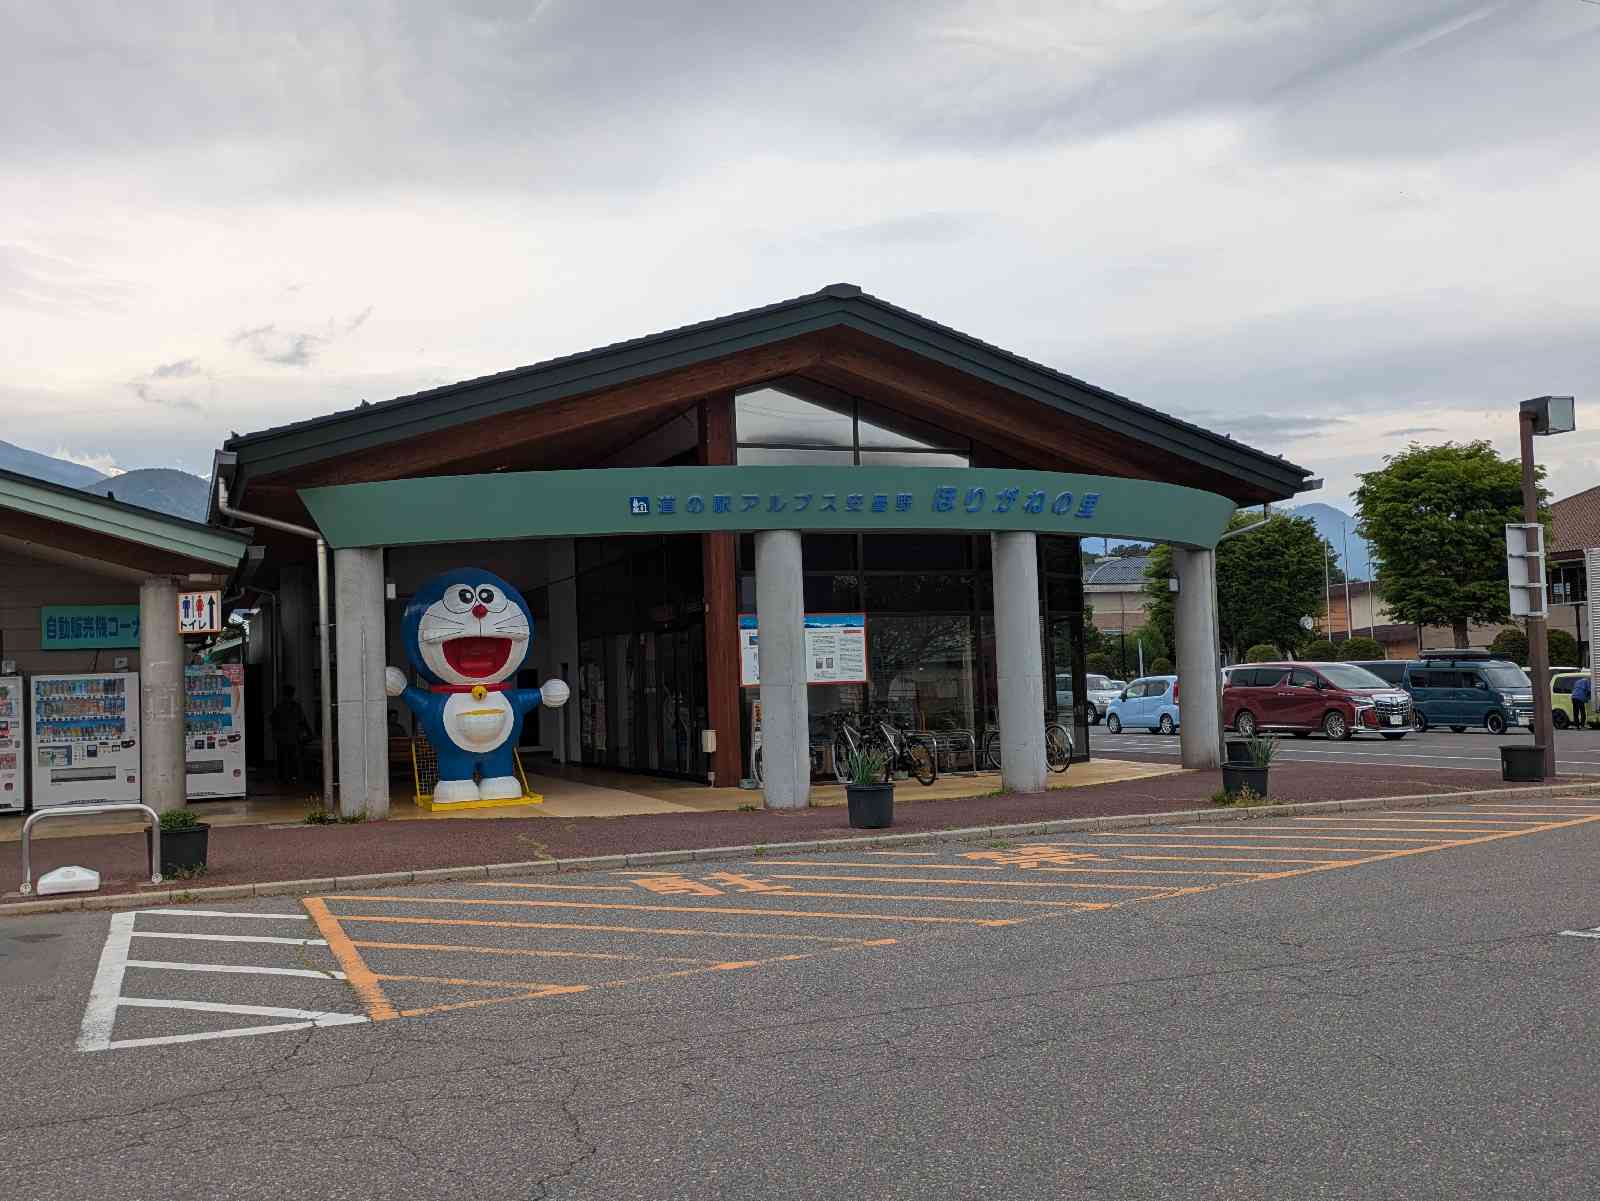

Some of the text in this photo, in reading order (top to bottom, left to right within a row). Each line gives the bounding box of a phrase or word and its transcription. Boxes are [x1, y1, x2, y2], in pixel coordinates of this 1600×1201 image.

[932, 486, 1102, 519] ほりがねの里
[46, 615, 140, 641] 自動販売機コーナ
[180, 619, 207, 631] トイレ
